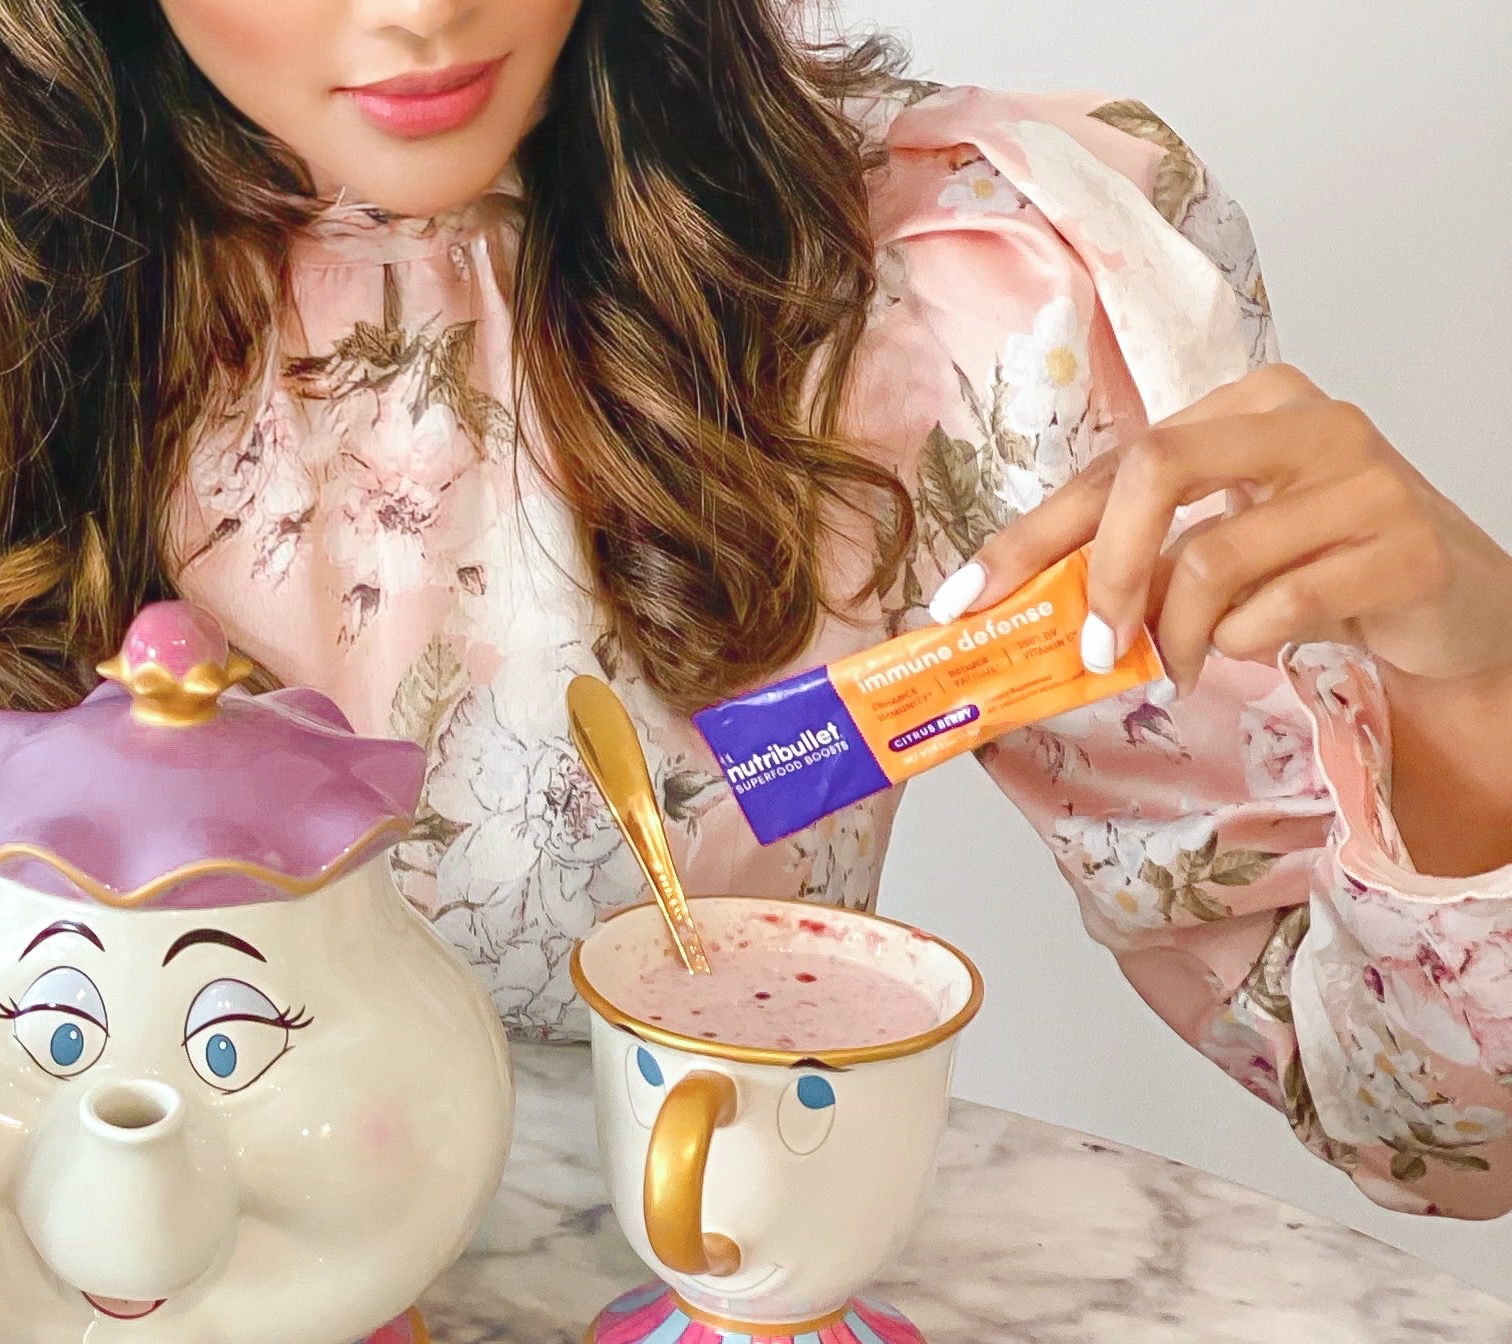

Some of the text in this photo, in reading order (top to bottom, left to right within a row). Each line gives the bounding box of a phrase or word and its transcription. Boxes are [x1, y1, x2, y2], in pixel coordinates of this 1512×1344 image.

[856, 644, 953, 693] immune
[957, 601, 1054, 652] defense
[872, 685, 918, 711] ENHANCE
[726, 721, 841, 784] nutribullet
[893, 723, 936, 748] CITRUS
[936, 707, 972, 730] BERRY
[735, 740, 849, 795] SUPERFOOD BOOSTS
